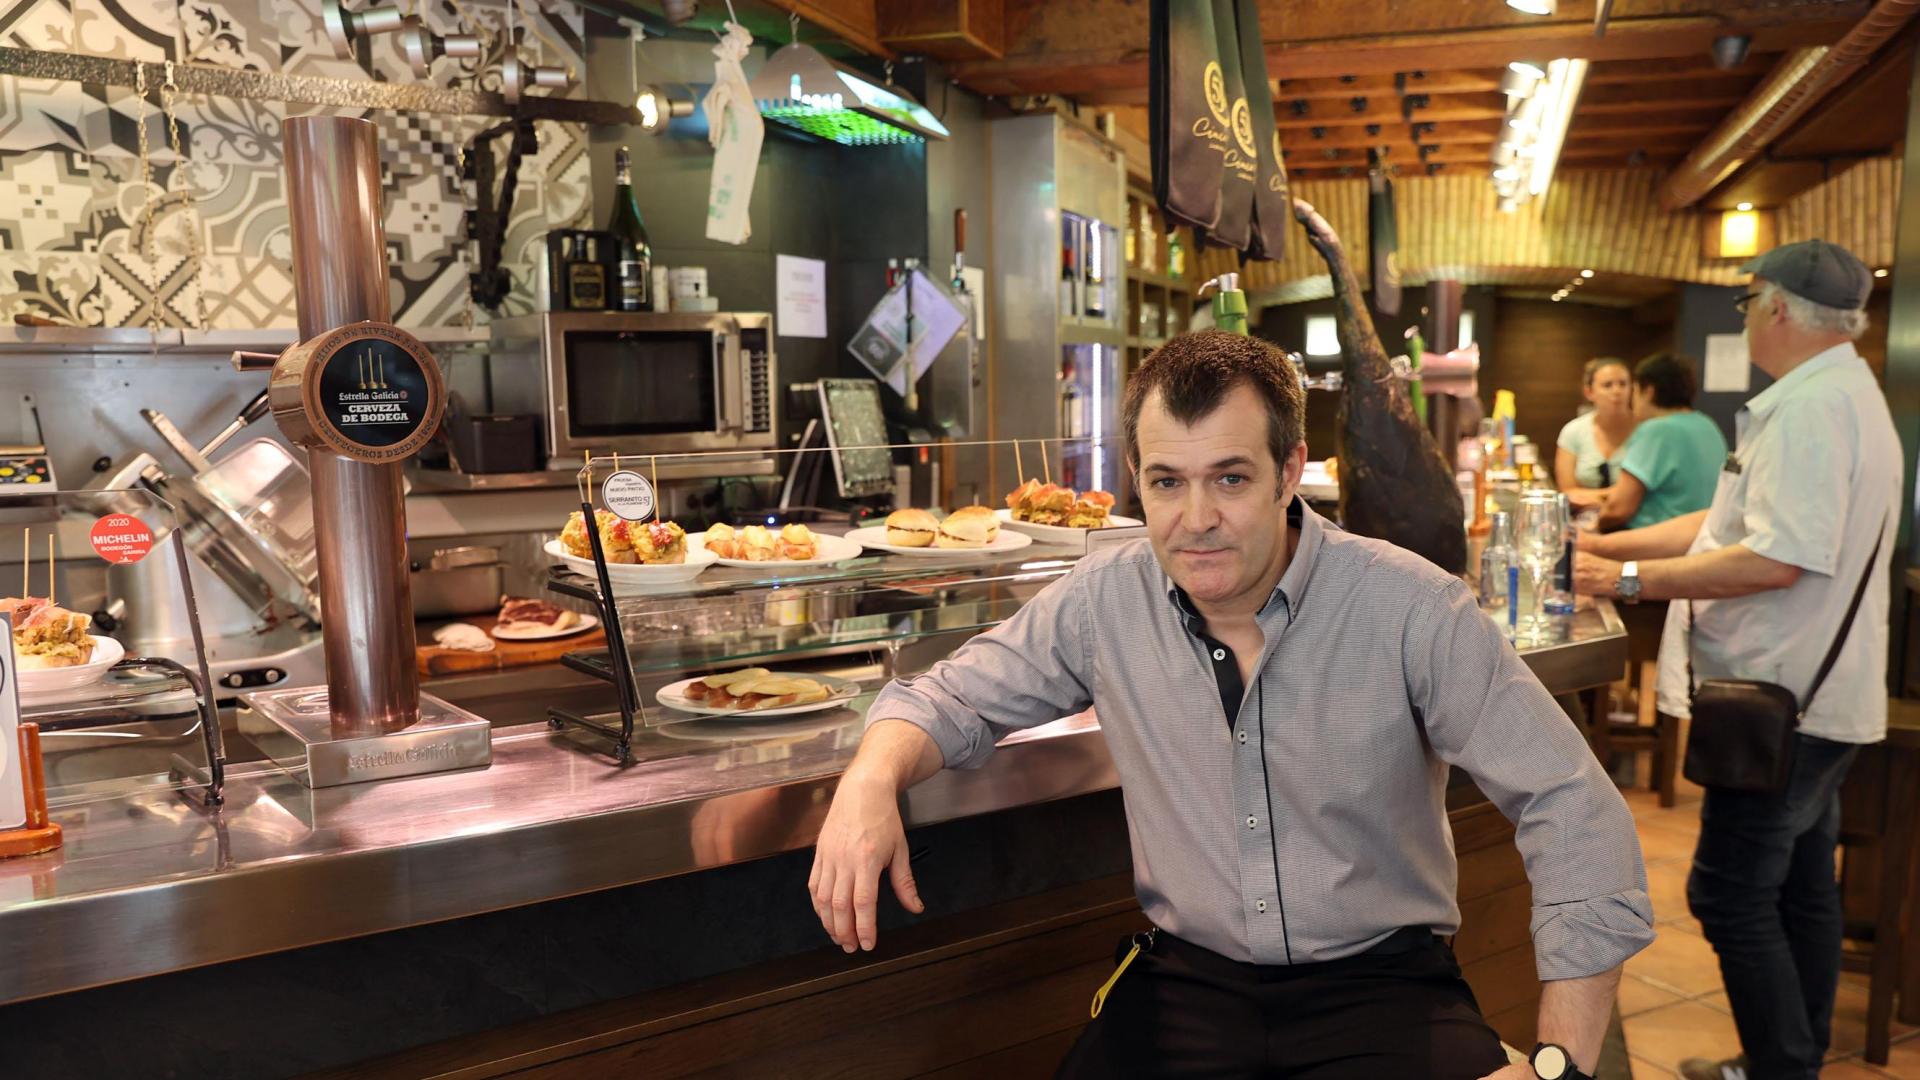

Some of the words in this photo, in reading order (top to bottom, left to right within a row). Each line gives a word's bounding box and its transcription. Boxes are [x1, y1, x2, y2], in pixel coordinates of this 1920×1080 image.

[339, 391, 370, 401] Estrella
[371, 391, 399, 401] Galicia
[348, 403, 401, 413] CERVEZA
[342, 414, 359, 423] DE
[360, 412, 409, 422] BODEGA
[386, 439, 418, 458] DESDE
[107, 517, 130, 527] 2020
[93, 533, 149, 545] MICHELIN
